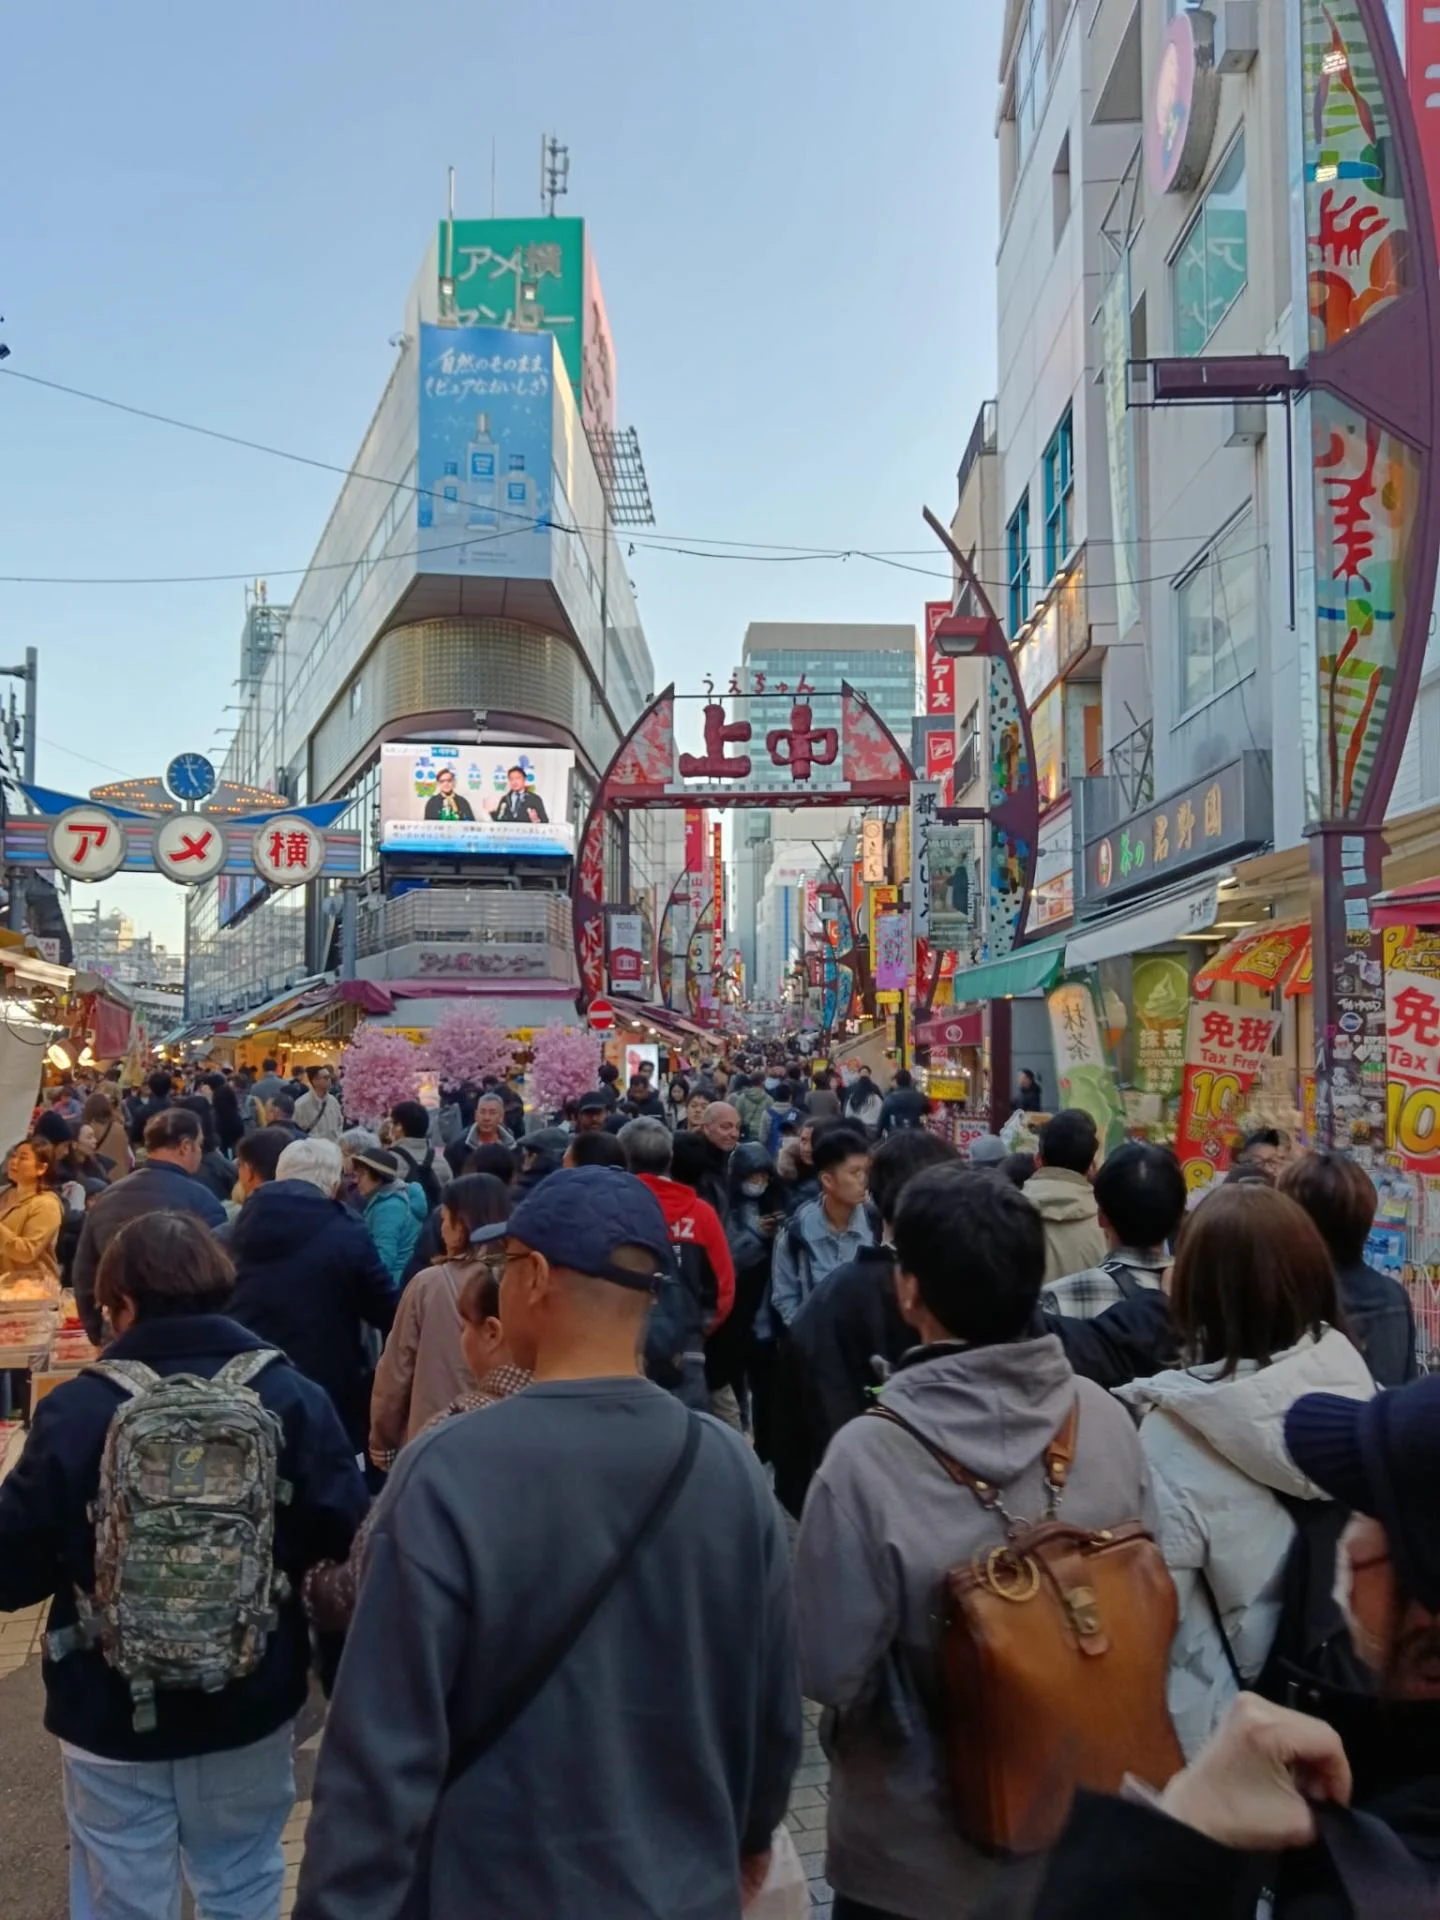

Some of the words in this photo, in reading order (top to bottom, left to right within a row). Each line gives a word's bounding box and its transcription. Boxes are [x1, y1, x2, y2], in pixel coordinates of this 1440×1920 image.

[458, 242, 562, 281] アメ横
[679, 704, 838, 778] 上中
[67, 824, 309, 869] アメ横
[1200, 1010, 1274, 1054] 免税
[1200, 1049, 1228, 1064] Tax
